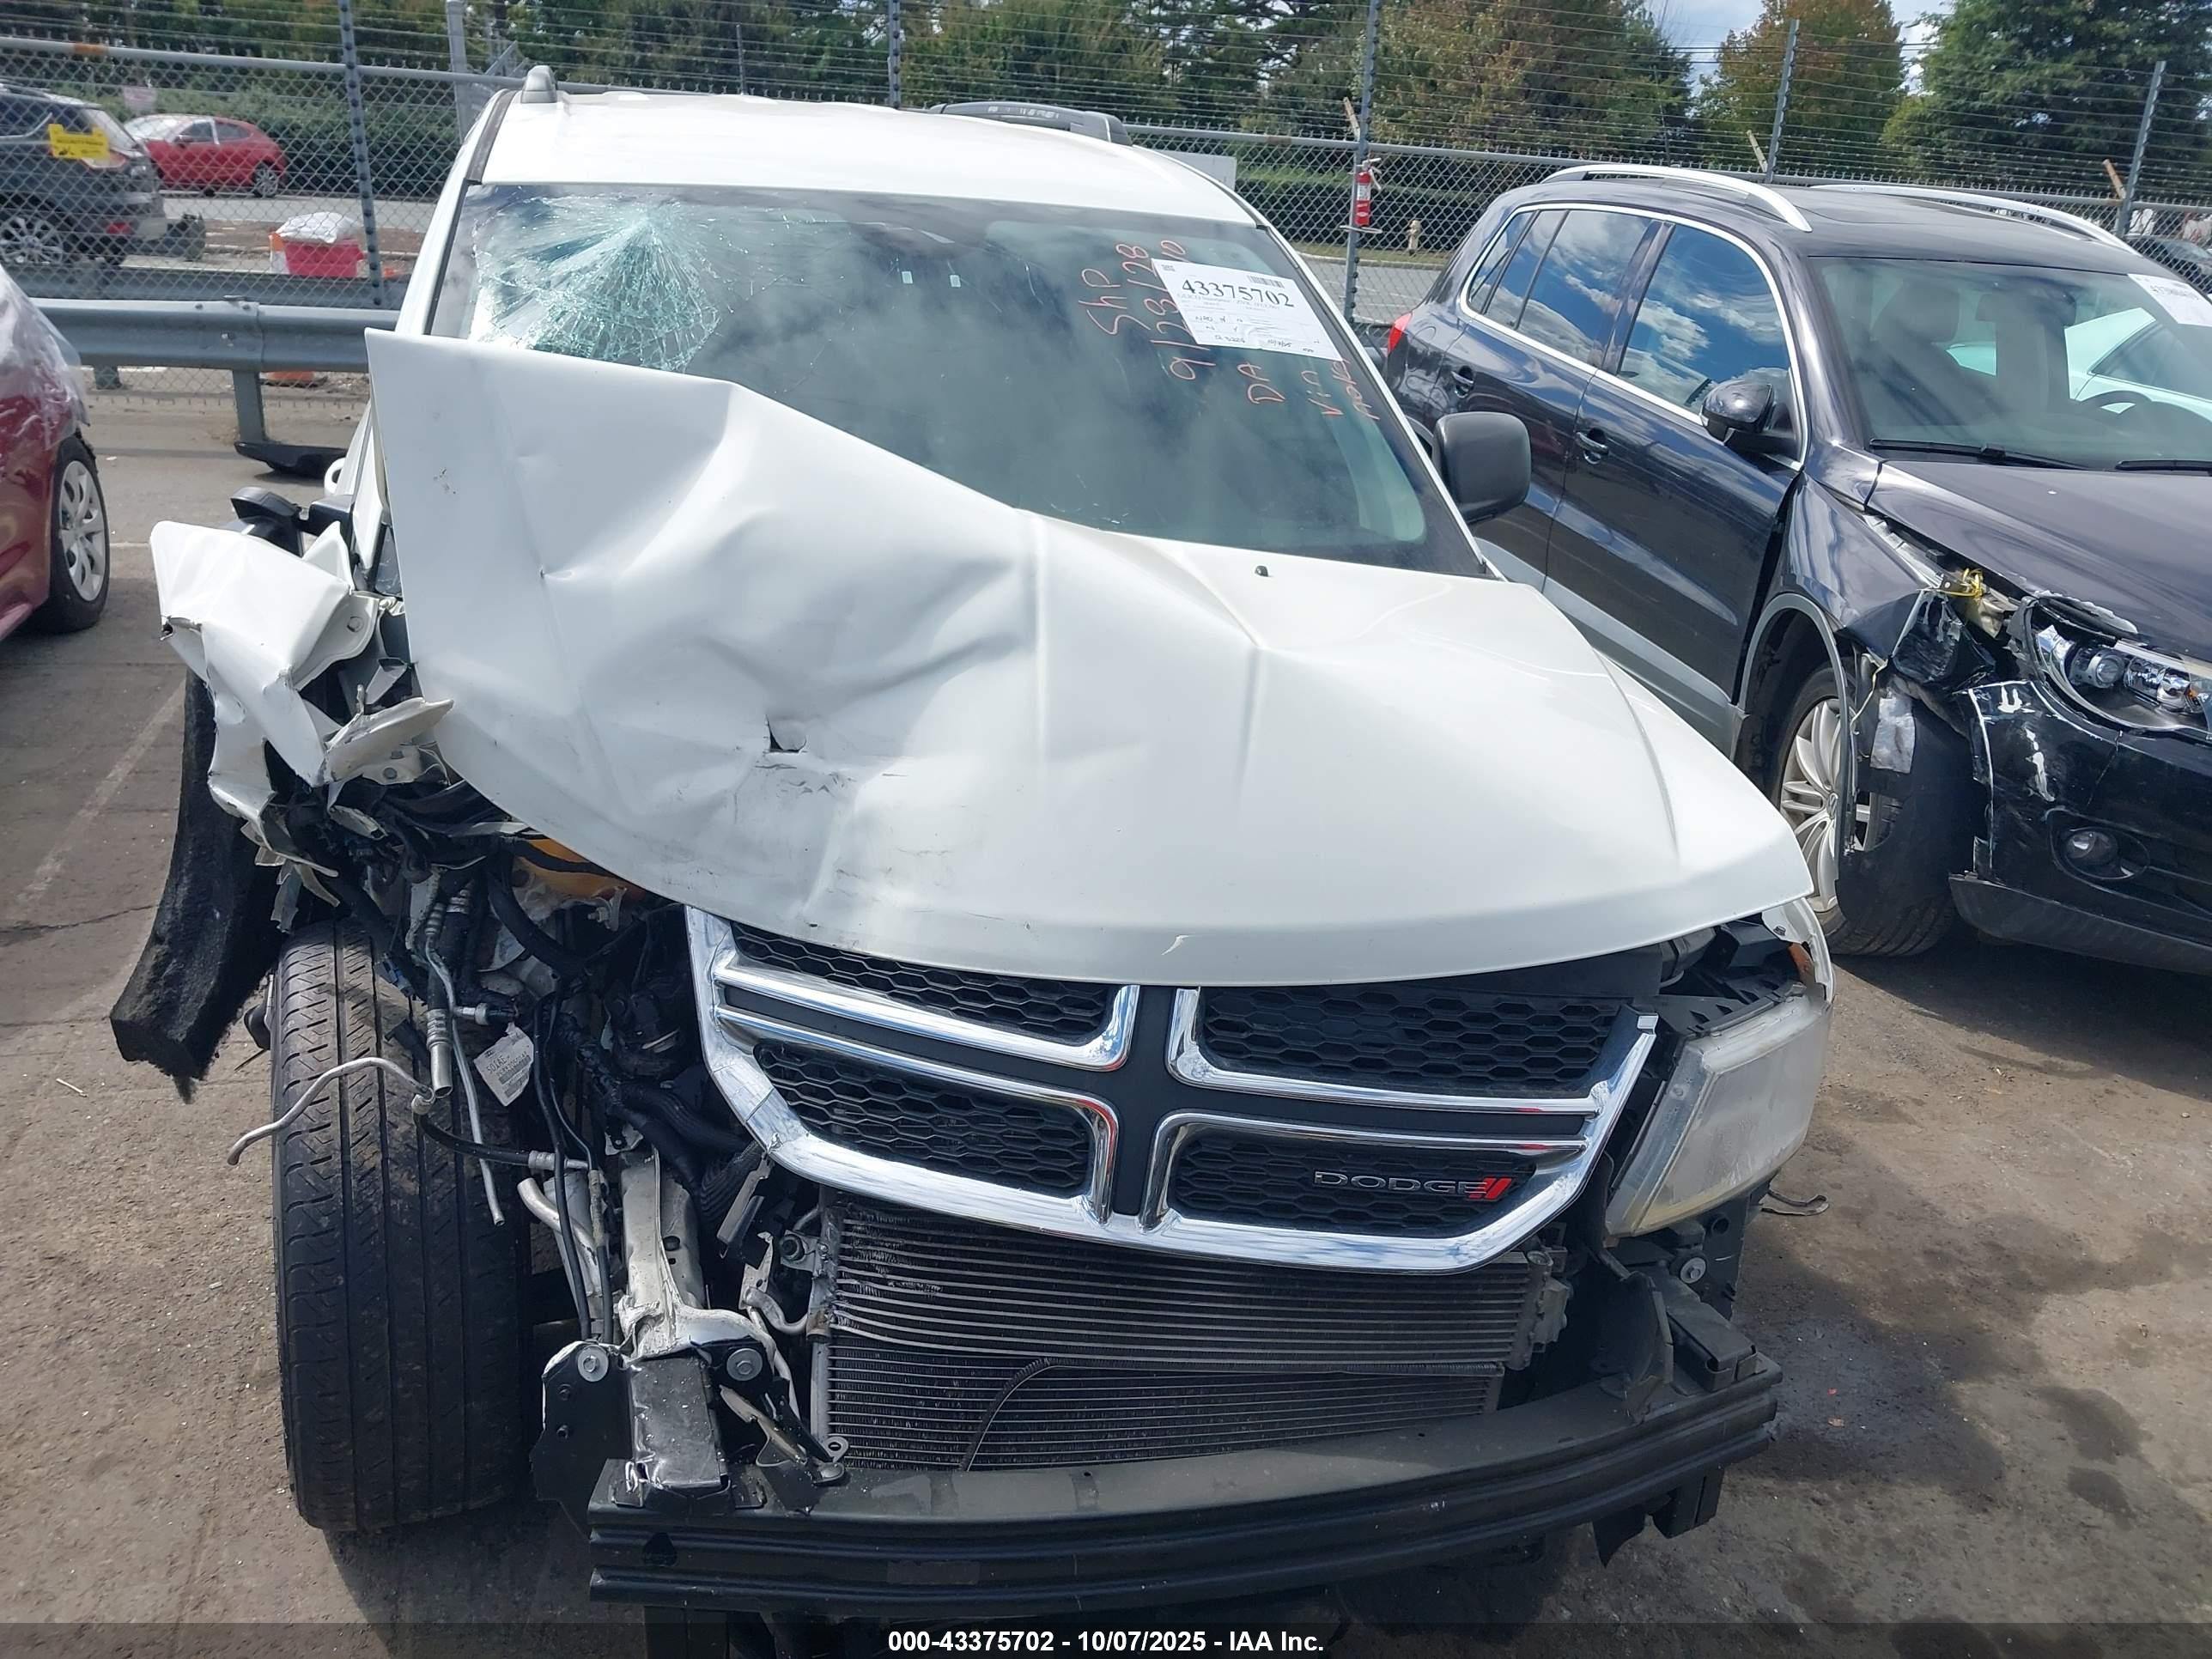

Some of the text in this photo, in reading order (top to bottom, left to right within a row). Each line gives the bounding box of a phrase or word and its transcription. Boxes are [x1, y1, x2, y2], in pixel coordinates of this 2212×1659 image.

[1182, 278, 1295, 308] 43375702
[1237, 362, 1285, 404] DA
[1314, 1170, 1488, 1195] DODGE
